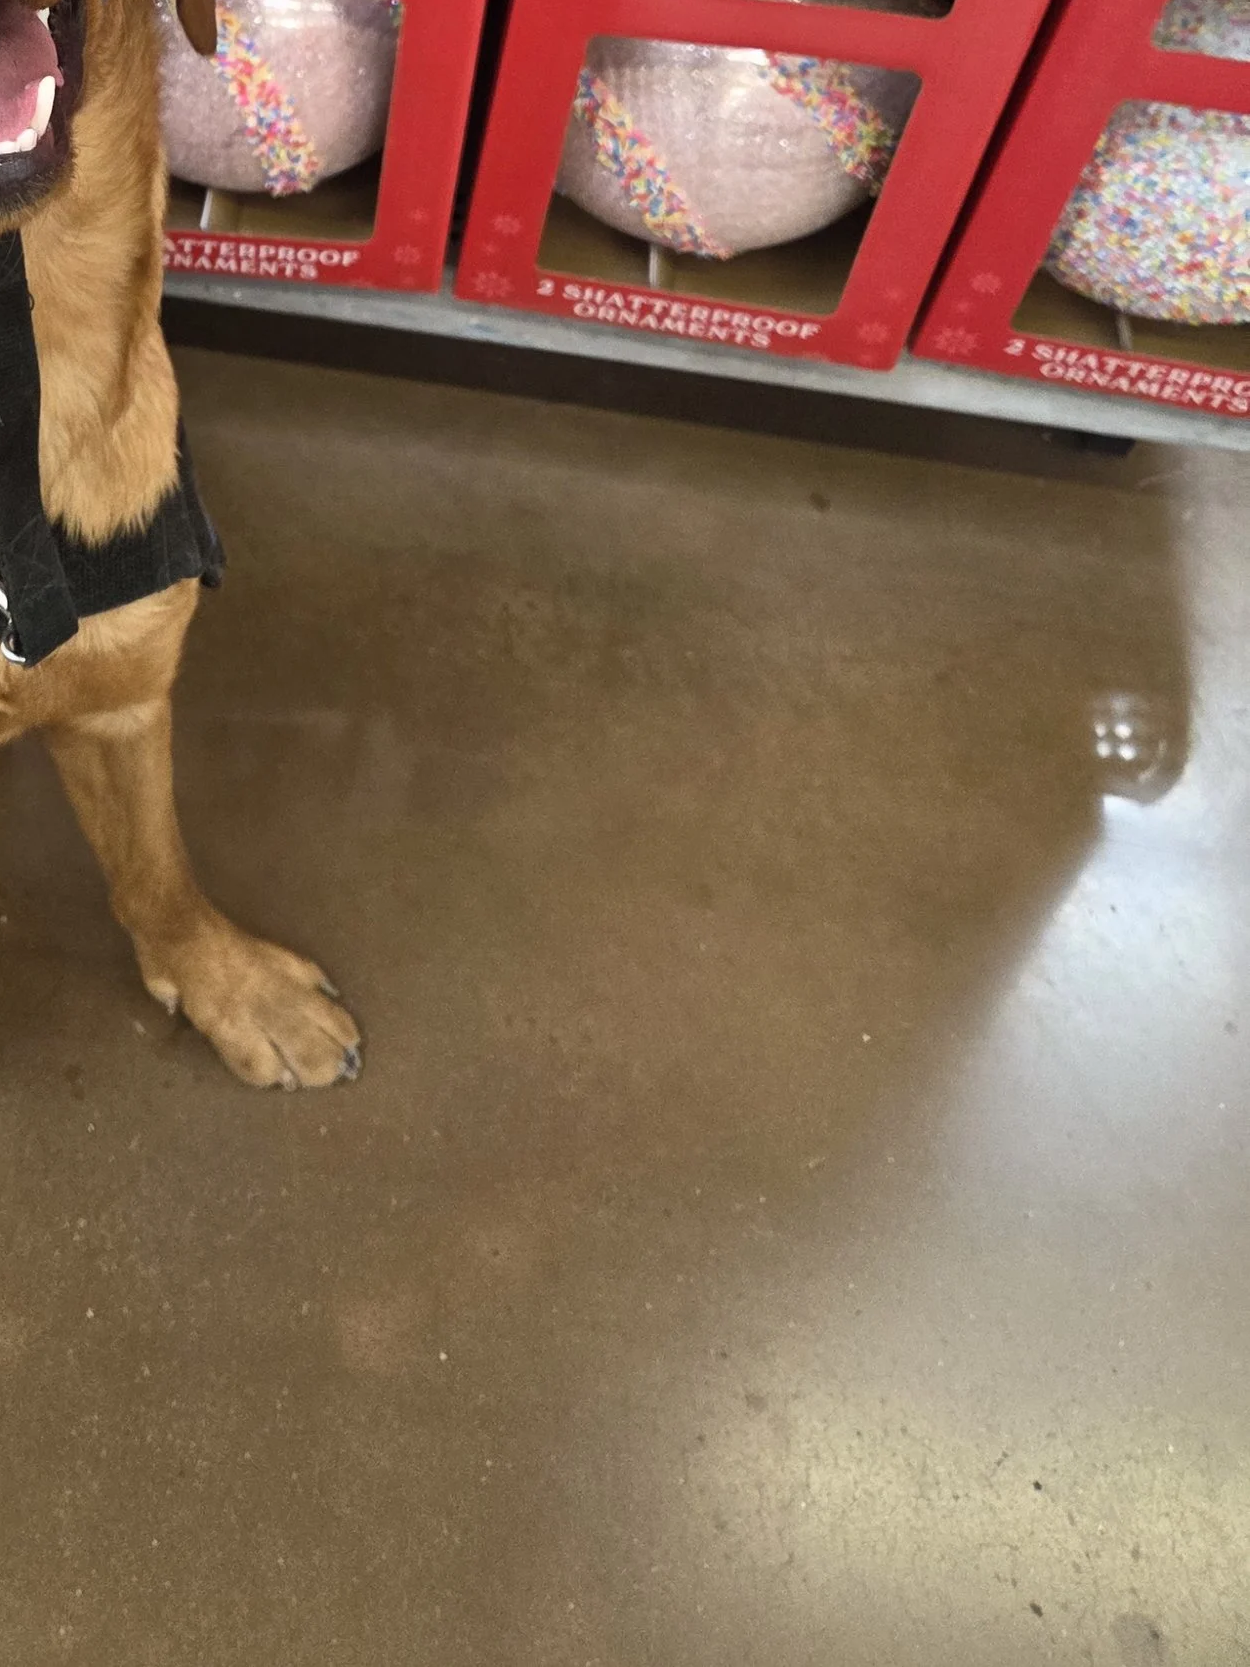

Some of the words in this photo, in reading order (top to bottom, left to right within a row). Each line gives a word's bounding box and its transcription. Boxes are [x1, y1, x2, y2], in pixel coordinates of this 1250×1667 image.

[536, 279, 555, 297] 2
[562, 283, 822, 340] SHATTERPROOF
[573, 302, 771, 349] ORNAMENTS
[1003, 338, 1026, 356] 2
[1038, 362, 1250, 413] ORNAMENTS
